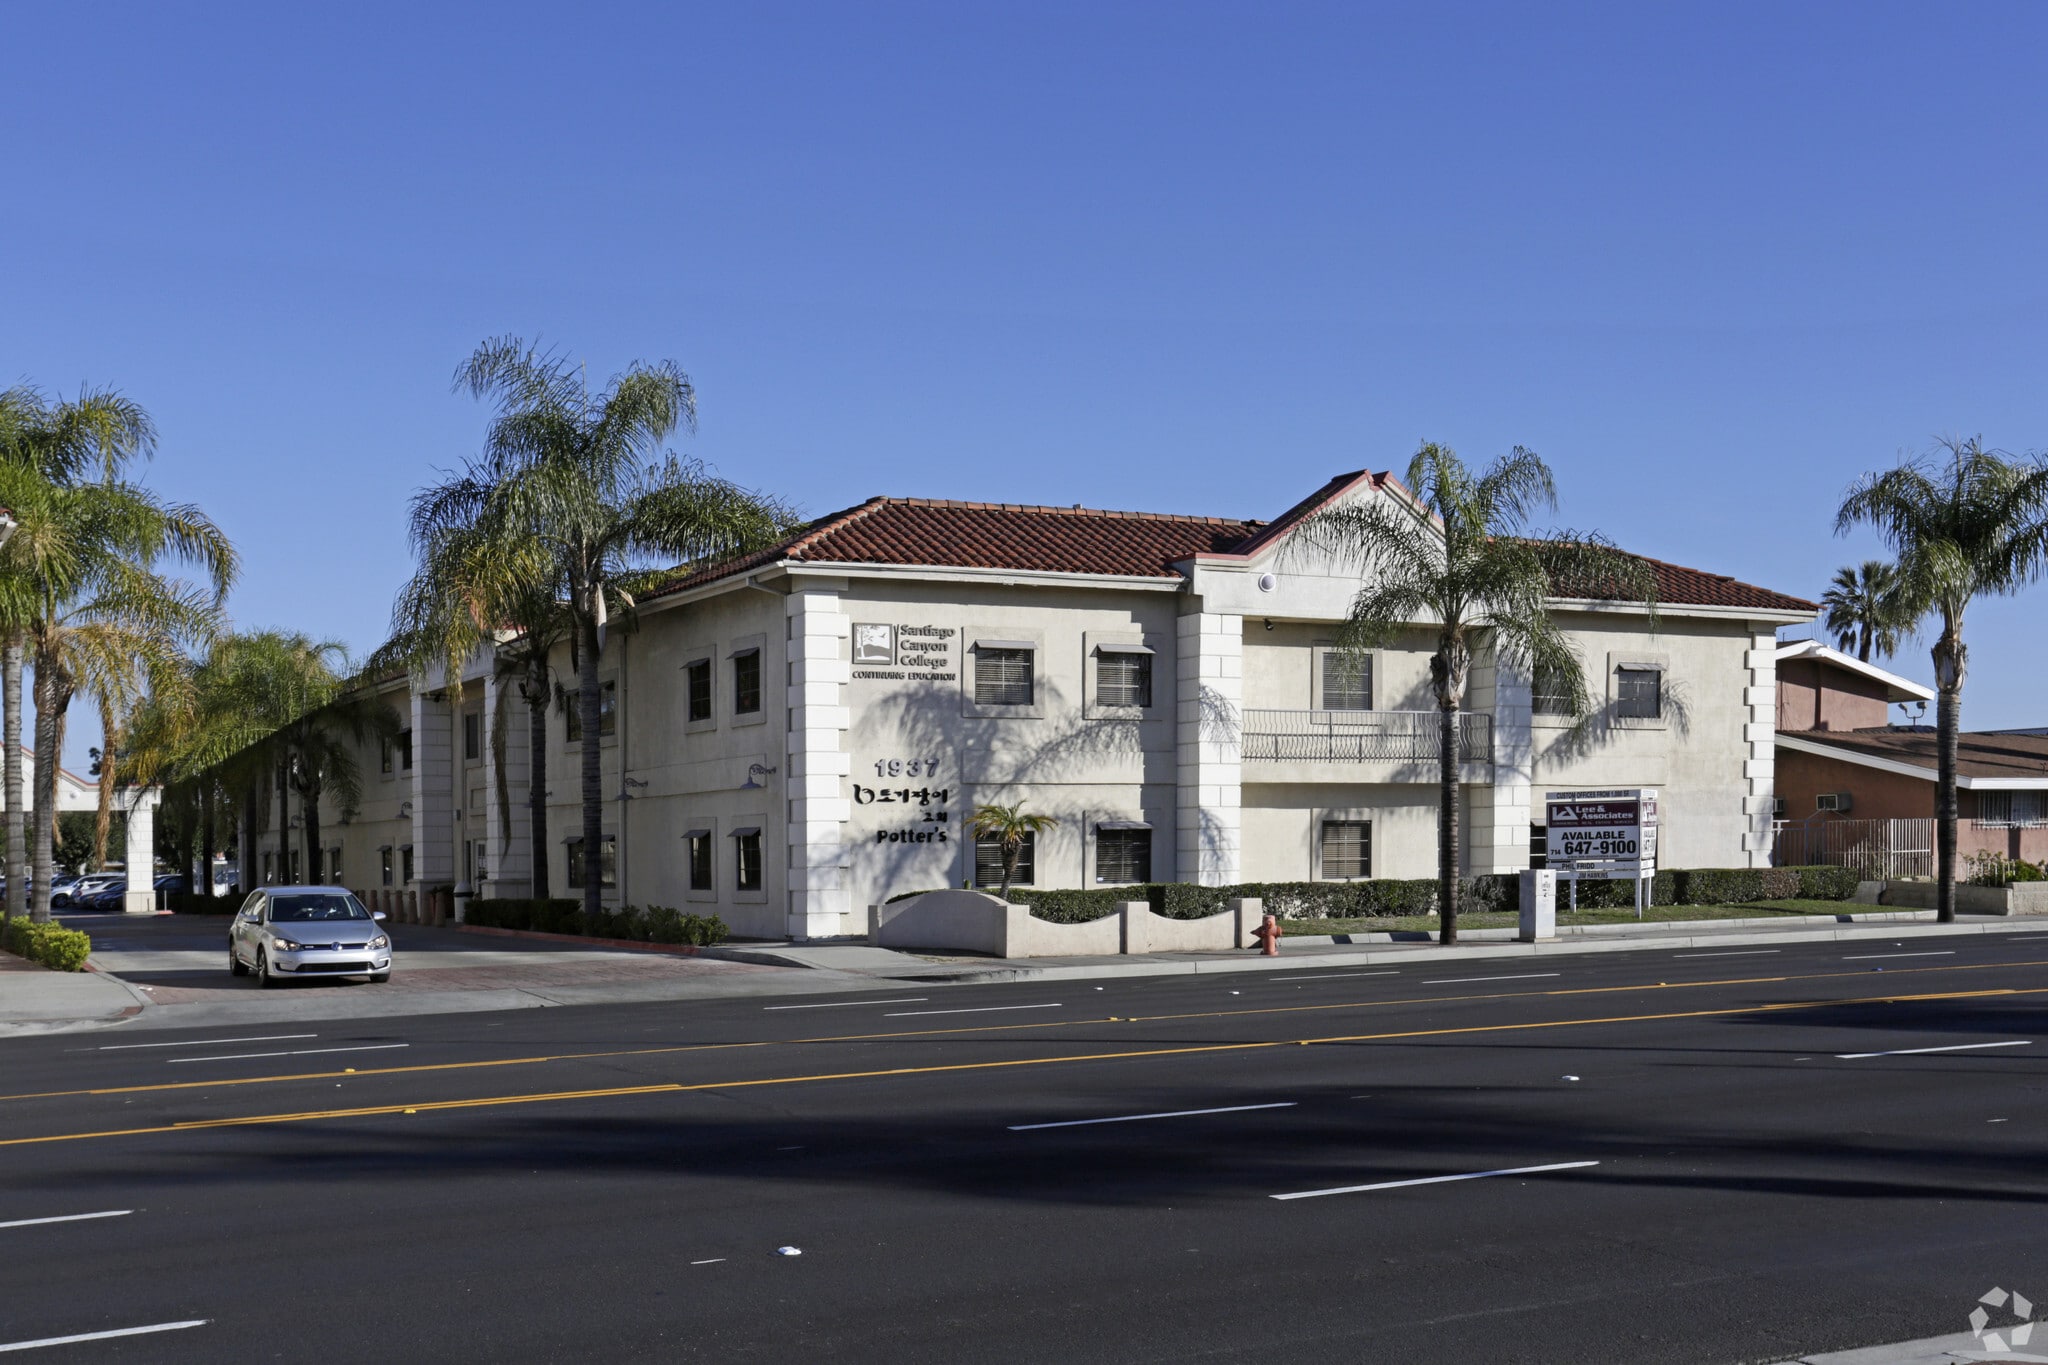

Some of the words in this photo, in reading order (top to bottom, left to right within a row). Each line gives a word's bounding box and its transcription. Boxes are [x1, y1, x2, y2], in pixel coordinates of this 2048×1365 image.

[900, 624, 956, 640] Santiago
[900, 640, 948, 654] Canyon
[900, 655, 948, 670] College
[852, 671, 905, 680] CONTINUING
[908, 672, 956, 681] EDUCATION
[874, 758, 940, 778] 1937
[1575, 805, 1596, 813] Lee
[1597, 805, 1606, 813] &
[1581, 812, 1634, 820] Associates
[876, 826, 947, 844] Potter's
[1561, 831, 1626, 841] AVAILABLE
[1564, 840, 1636, 855] 647-9100
